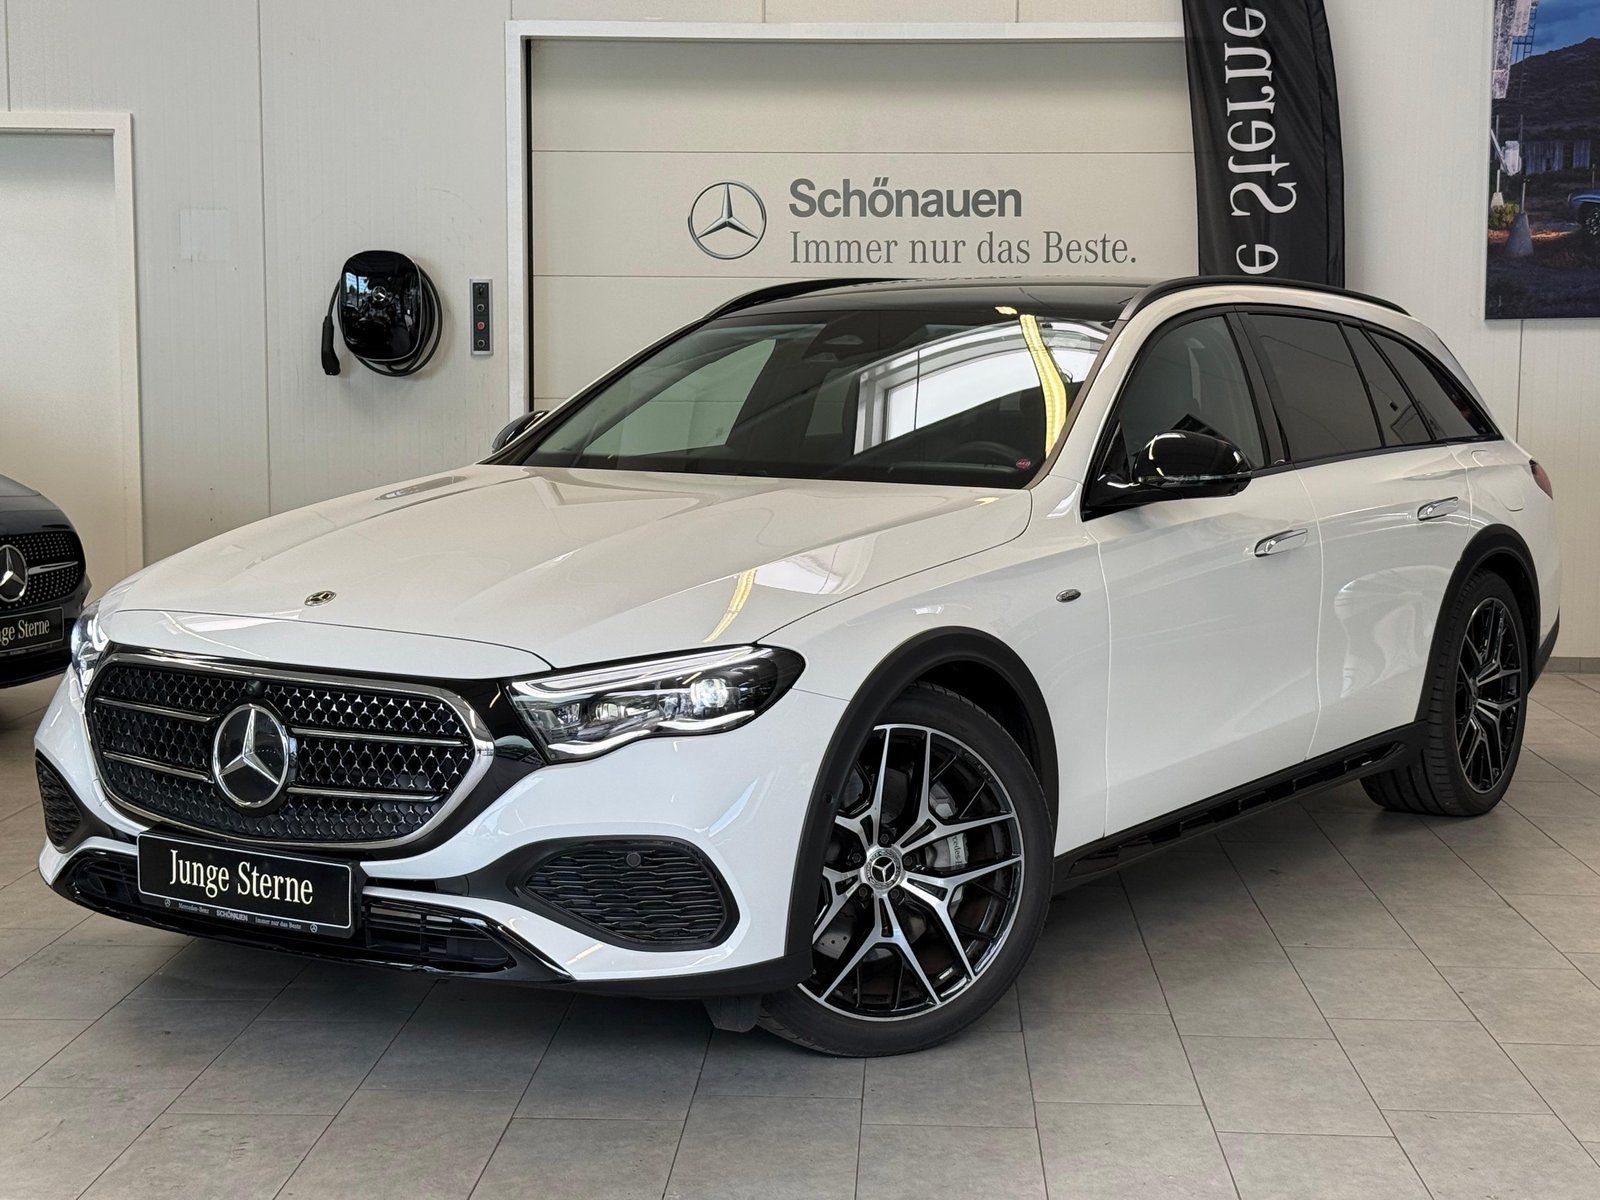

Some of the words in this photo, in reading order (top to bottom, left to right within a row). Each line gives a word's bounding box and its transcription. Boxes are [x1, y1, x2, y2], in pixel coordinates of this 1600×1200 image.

[789, 177, 1022, 218] Schönauen
[790, 231, 898, 264] Immer
[909, 239, 967, 264] nur
[977, 230, 1031, 265] das
[1043, 231, 1137, 264] Beste.
[18, 619, 50, 639] Sterne
[169, 849, 229, 897] Junge
[237, 861, 313, 905] Sterne
